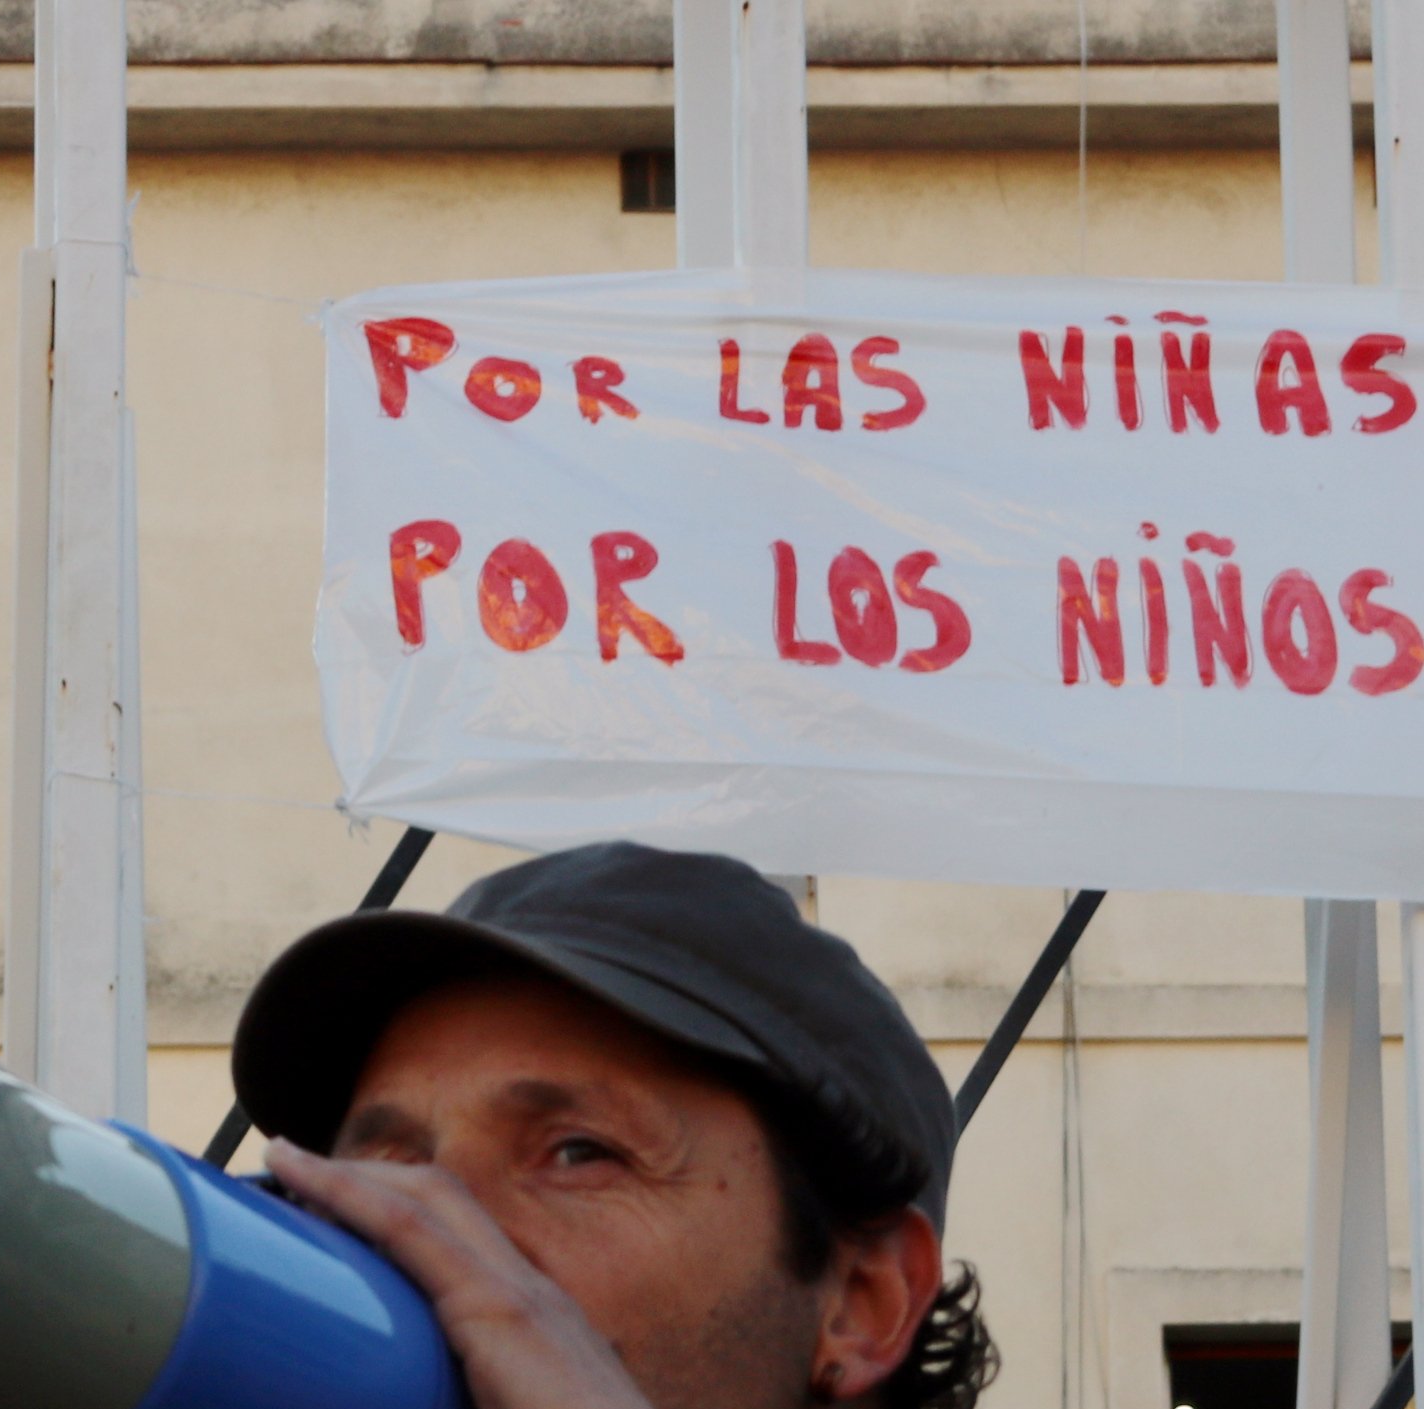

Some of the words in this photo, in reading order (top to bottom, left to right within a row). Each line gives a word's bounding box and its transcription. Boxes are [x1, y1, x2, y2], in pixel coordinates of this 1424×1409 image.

[361, 316, 642, 426] POR
[717, 332, 928, 434] LAS
[1016, 310, 1419, 439] NIÑAS
[387, 517, 687, 668] POR
[771, 538, 973, 675] LOS
